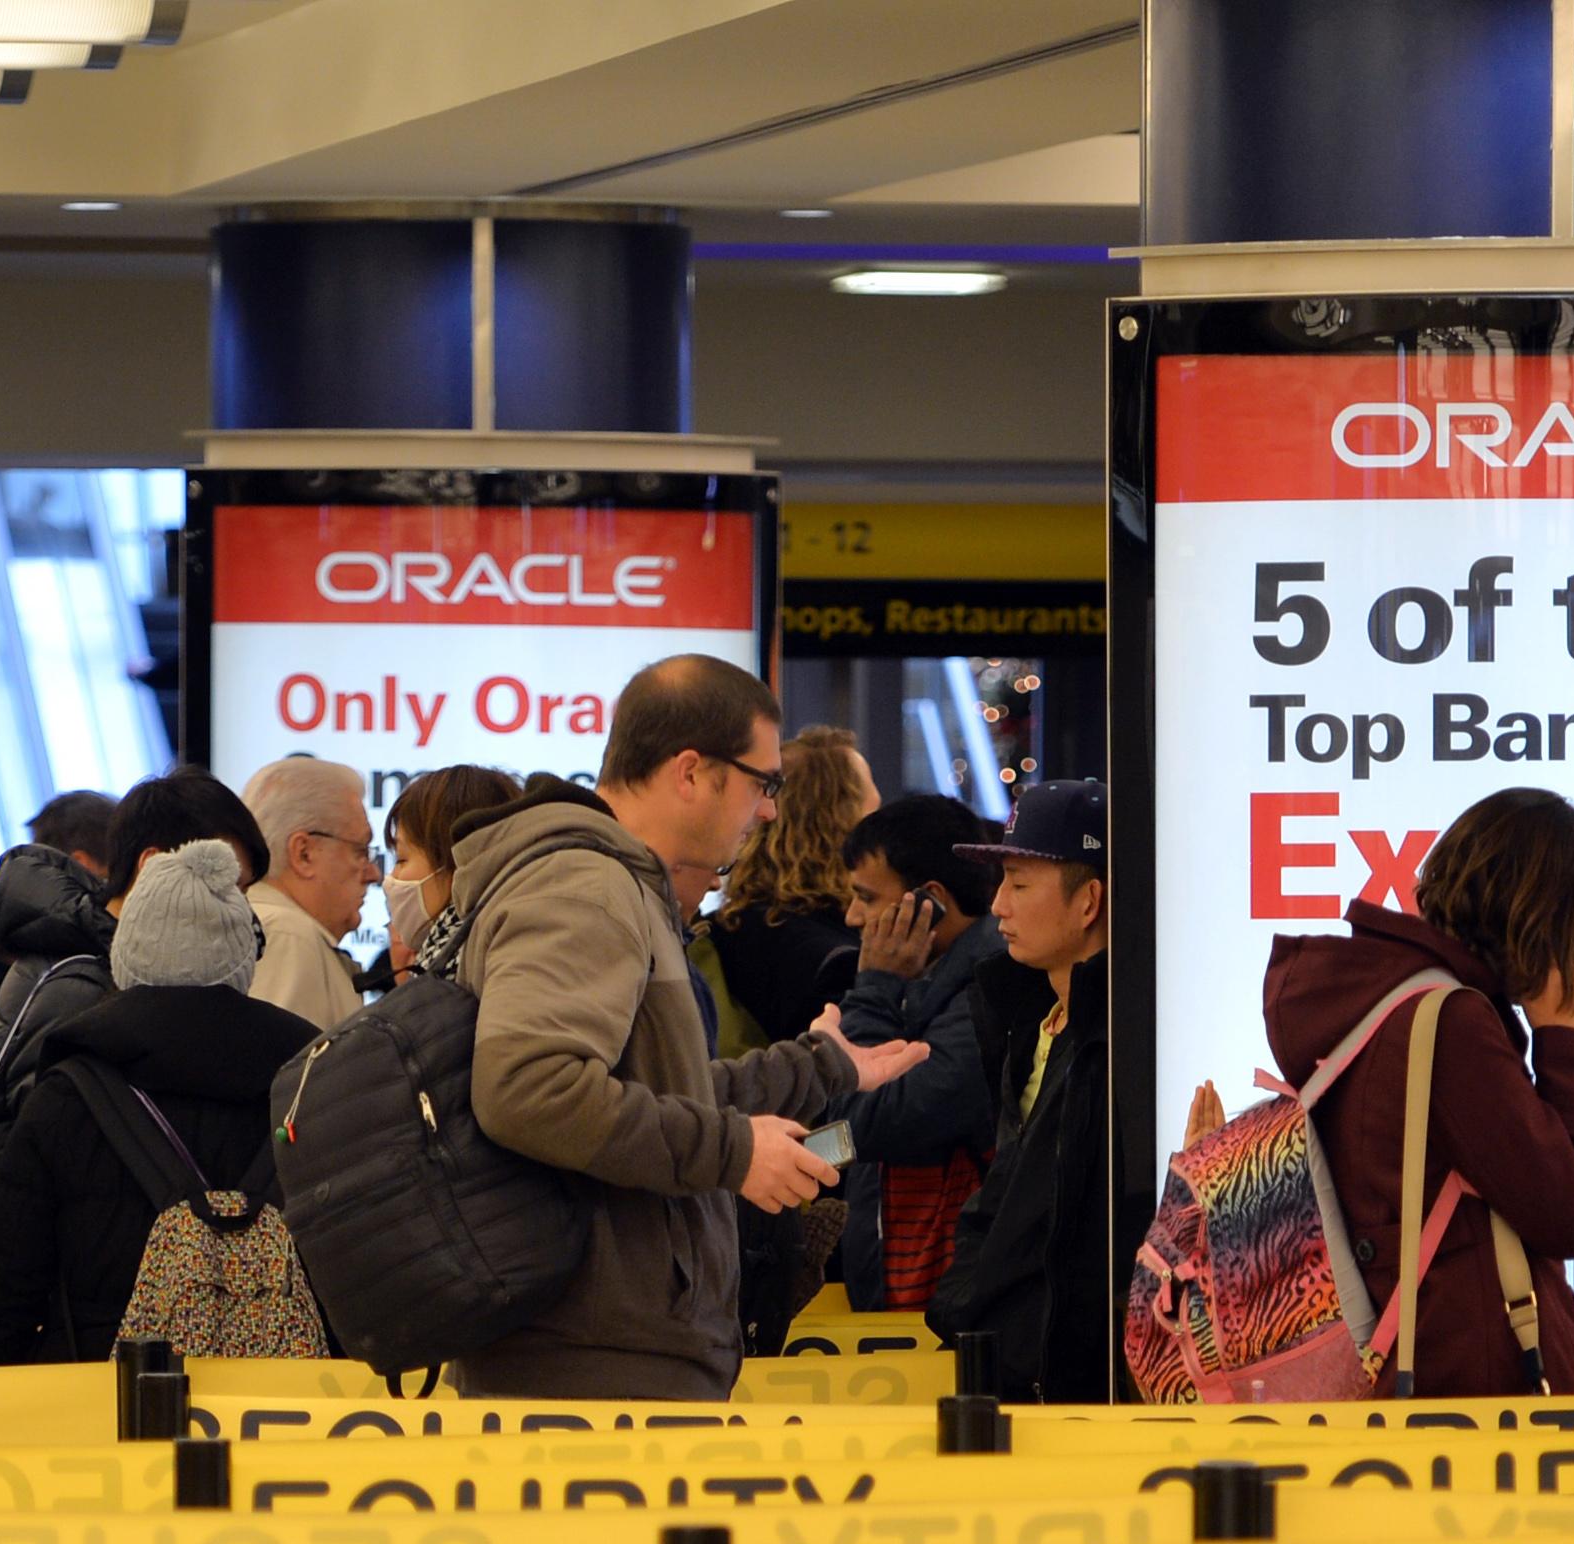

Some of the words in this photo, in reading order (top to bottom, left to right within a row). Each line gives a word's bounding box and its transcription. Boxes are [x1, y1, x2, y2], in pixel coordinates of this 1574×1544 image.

[833, 520, 874, 554] 12
[1253, 561, 1331, 666] 5
[1367, 555, 1514, 665] of
[277, 673, 448, 748] Only
[475, 675, 617, 735] Ora
[1249, 693, 1406, 780] Top
